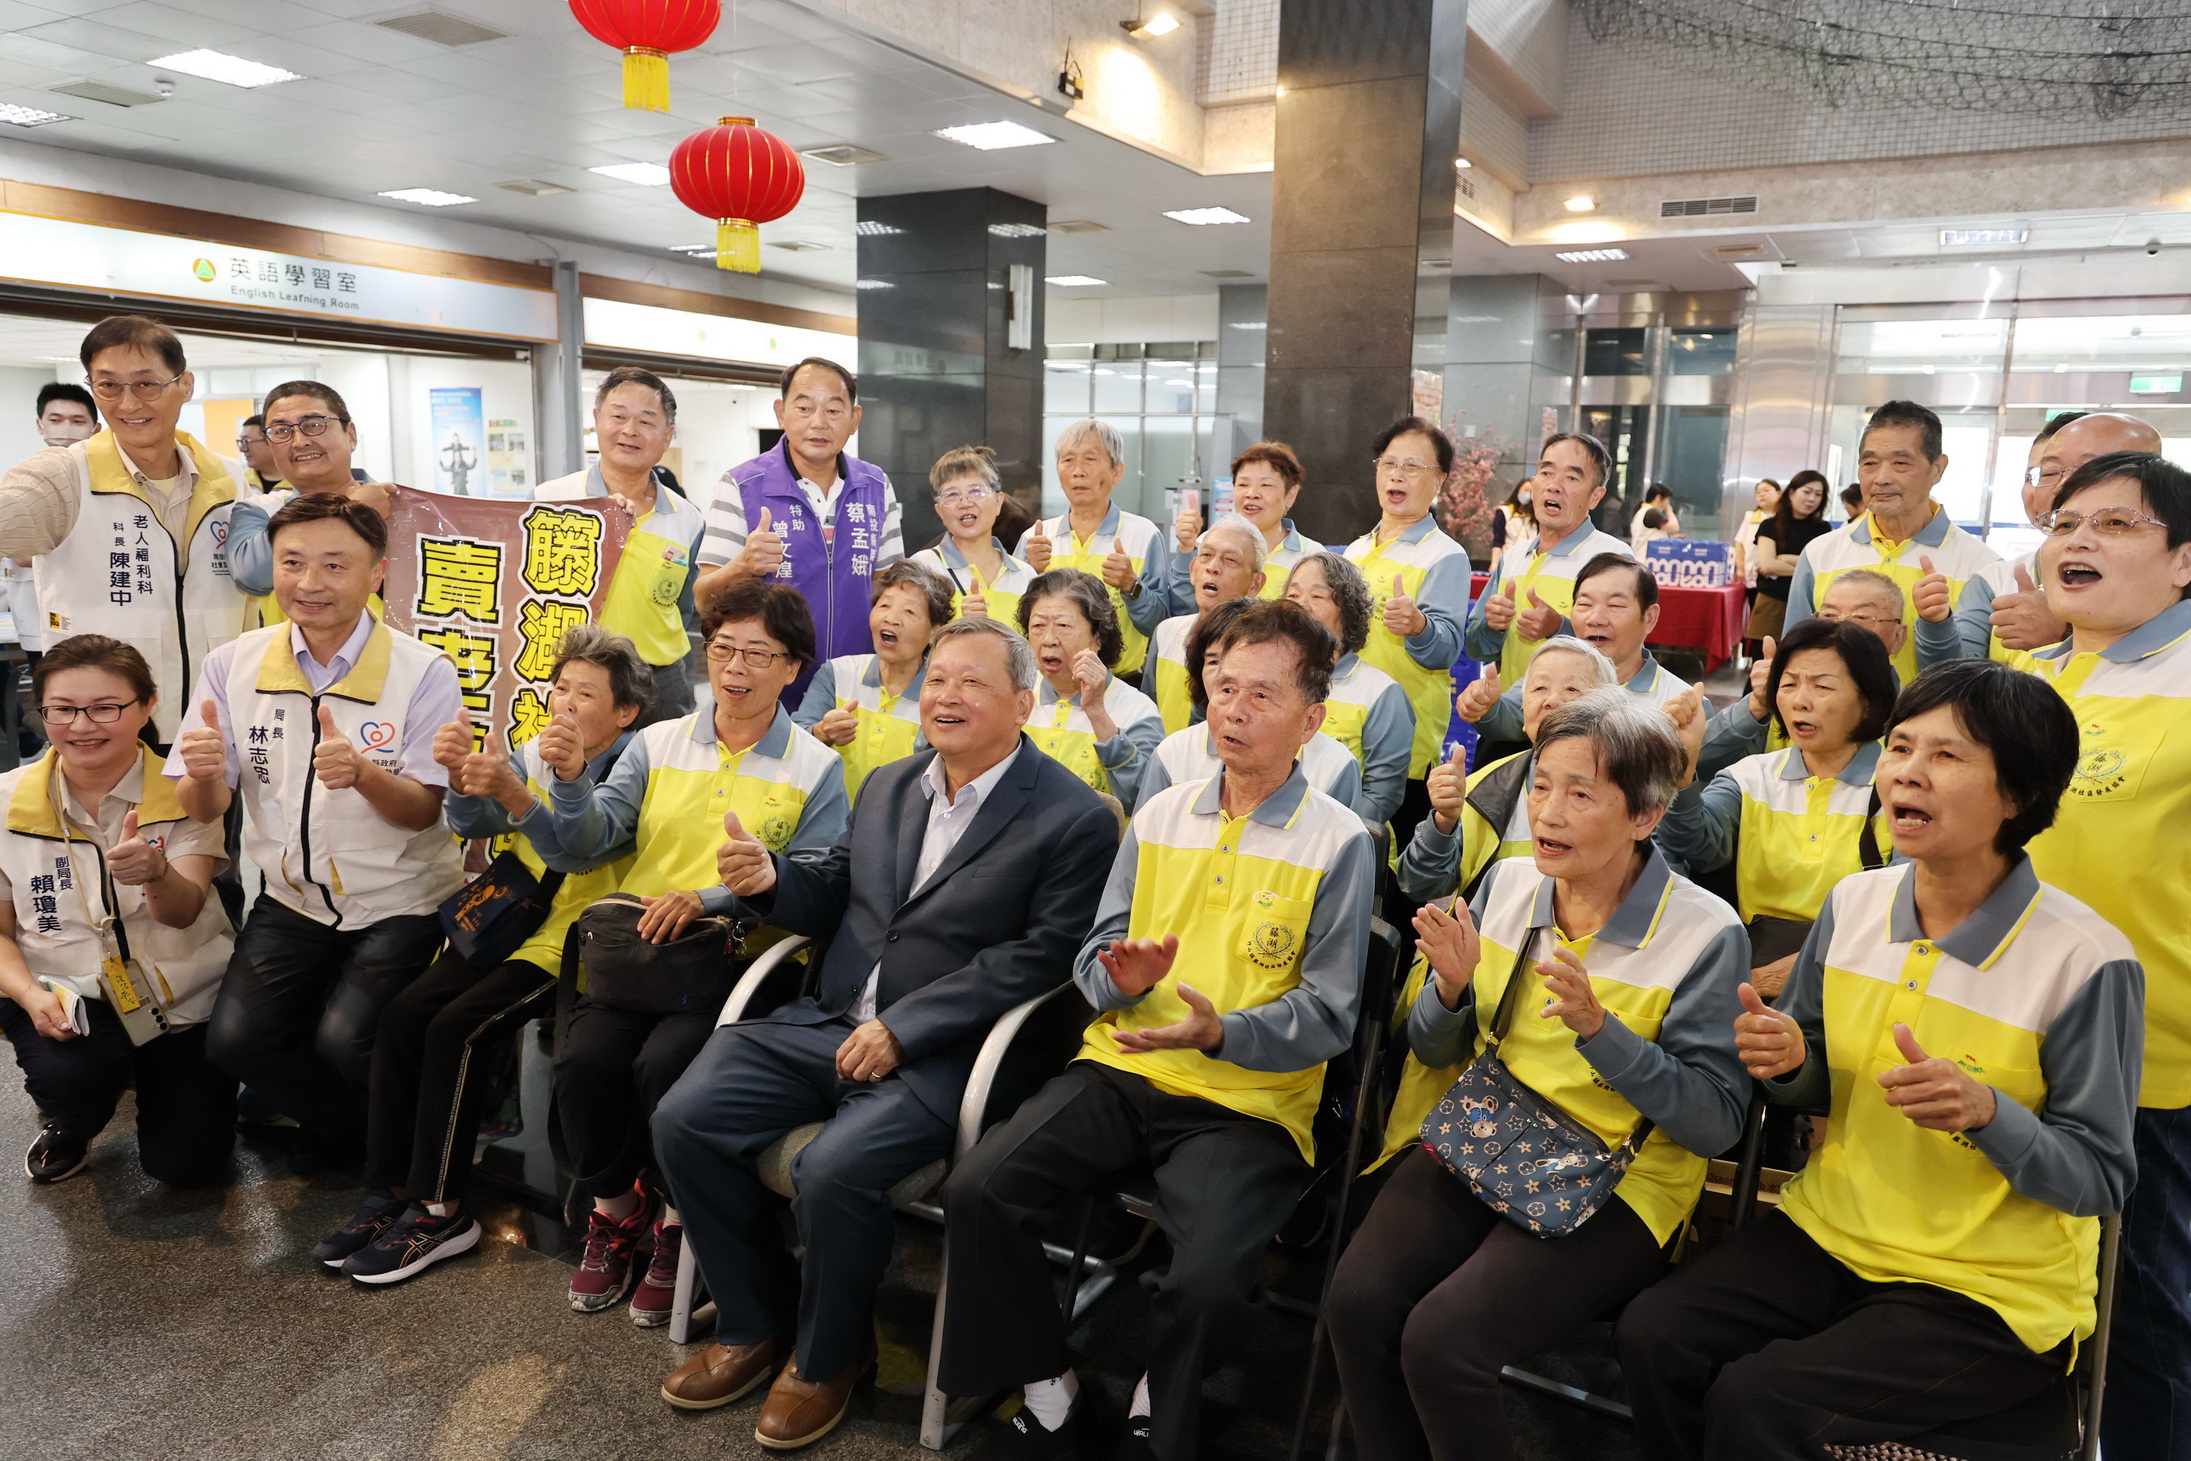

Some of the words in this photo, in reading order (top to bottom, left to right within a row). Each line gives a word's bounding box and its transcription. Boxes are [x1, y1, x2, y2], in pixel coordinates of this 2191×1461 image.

[229, 258, 357, 293] 英語學習室
[231, 285, 275, 299] English
[330, 298, 359, 311] Room
[113, 522, 125, 547] 科長
[789, 504, 805, 531] 特助
[133, 515, 153, 594] 老人福利科
[845, 502, 869, 576] 蔡孟娥
[110, 552, 132, 606] 陳建中
[272, 709, 285, 740] 局長
[249, 725, 270, 784] 林志忠
[55, 856, 73, 890] 副局長
[31, 874, 62, 933] 賴瓊美
